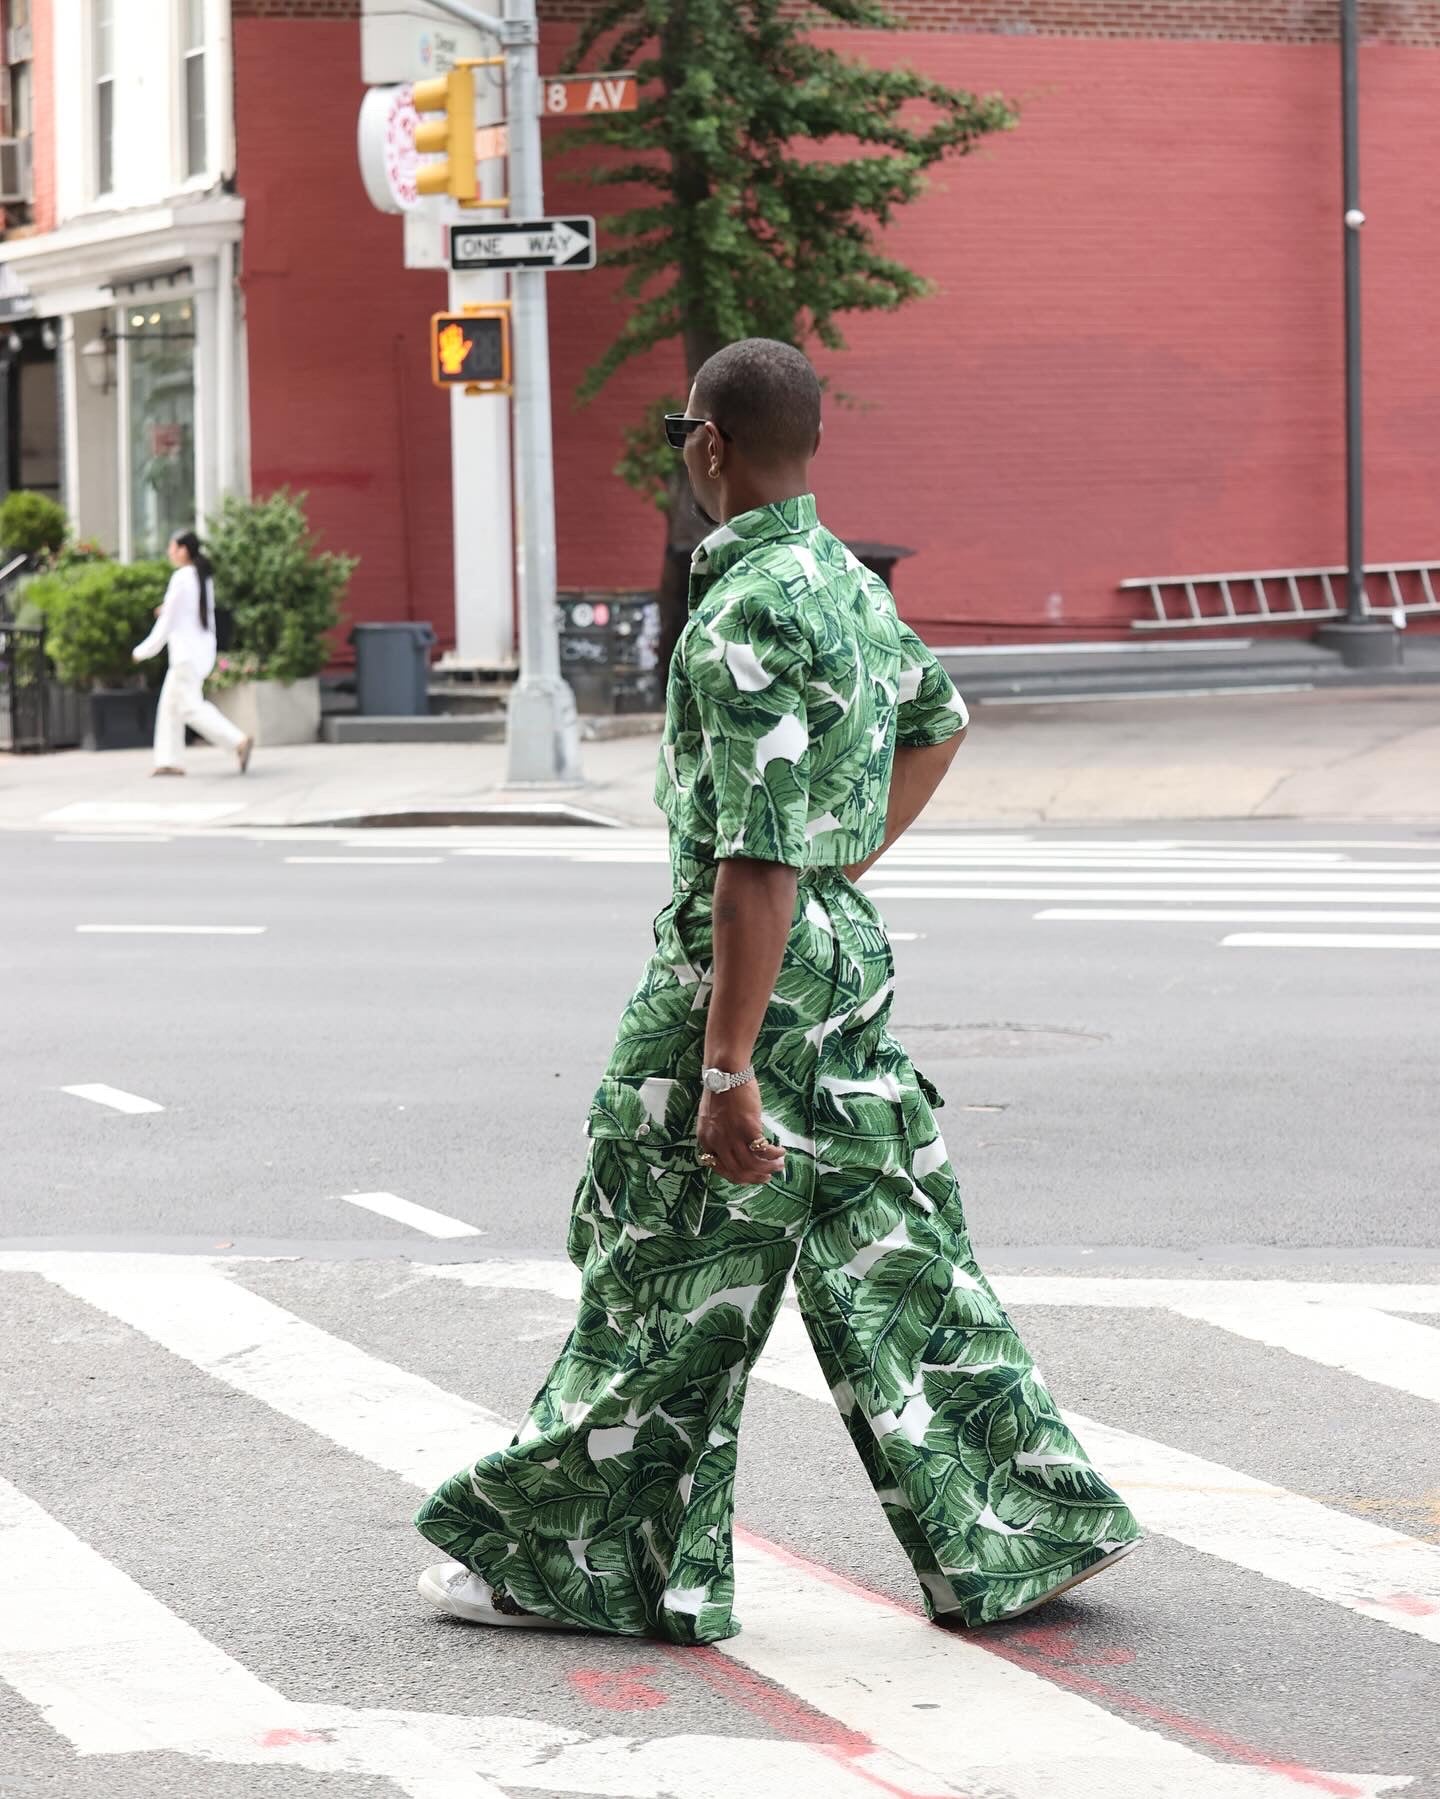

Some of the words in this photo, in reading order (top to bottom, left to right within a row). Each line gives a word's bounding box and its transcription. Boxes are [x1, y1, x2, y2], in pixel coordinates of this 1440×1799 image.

[547, 83, 567, 112] 8
[586, 80, 625, 110] AV
[463, 237, 502, 256] ONE
[528, 234, 572, 252] WAY
